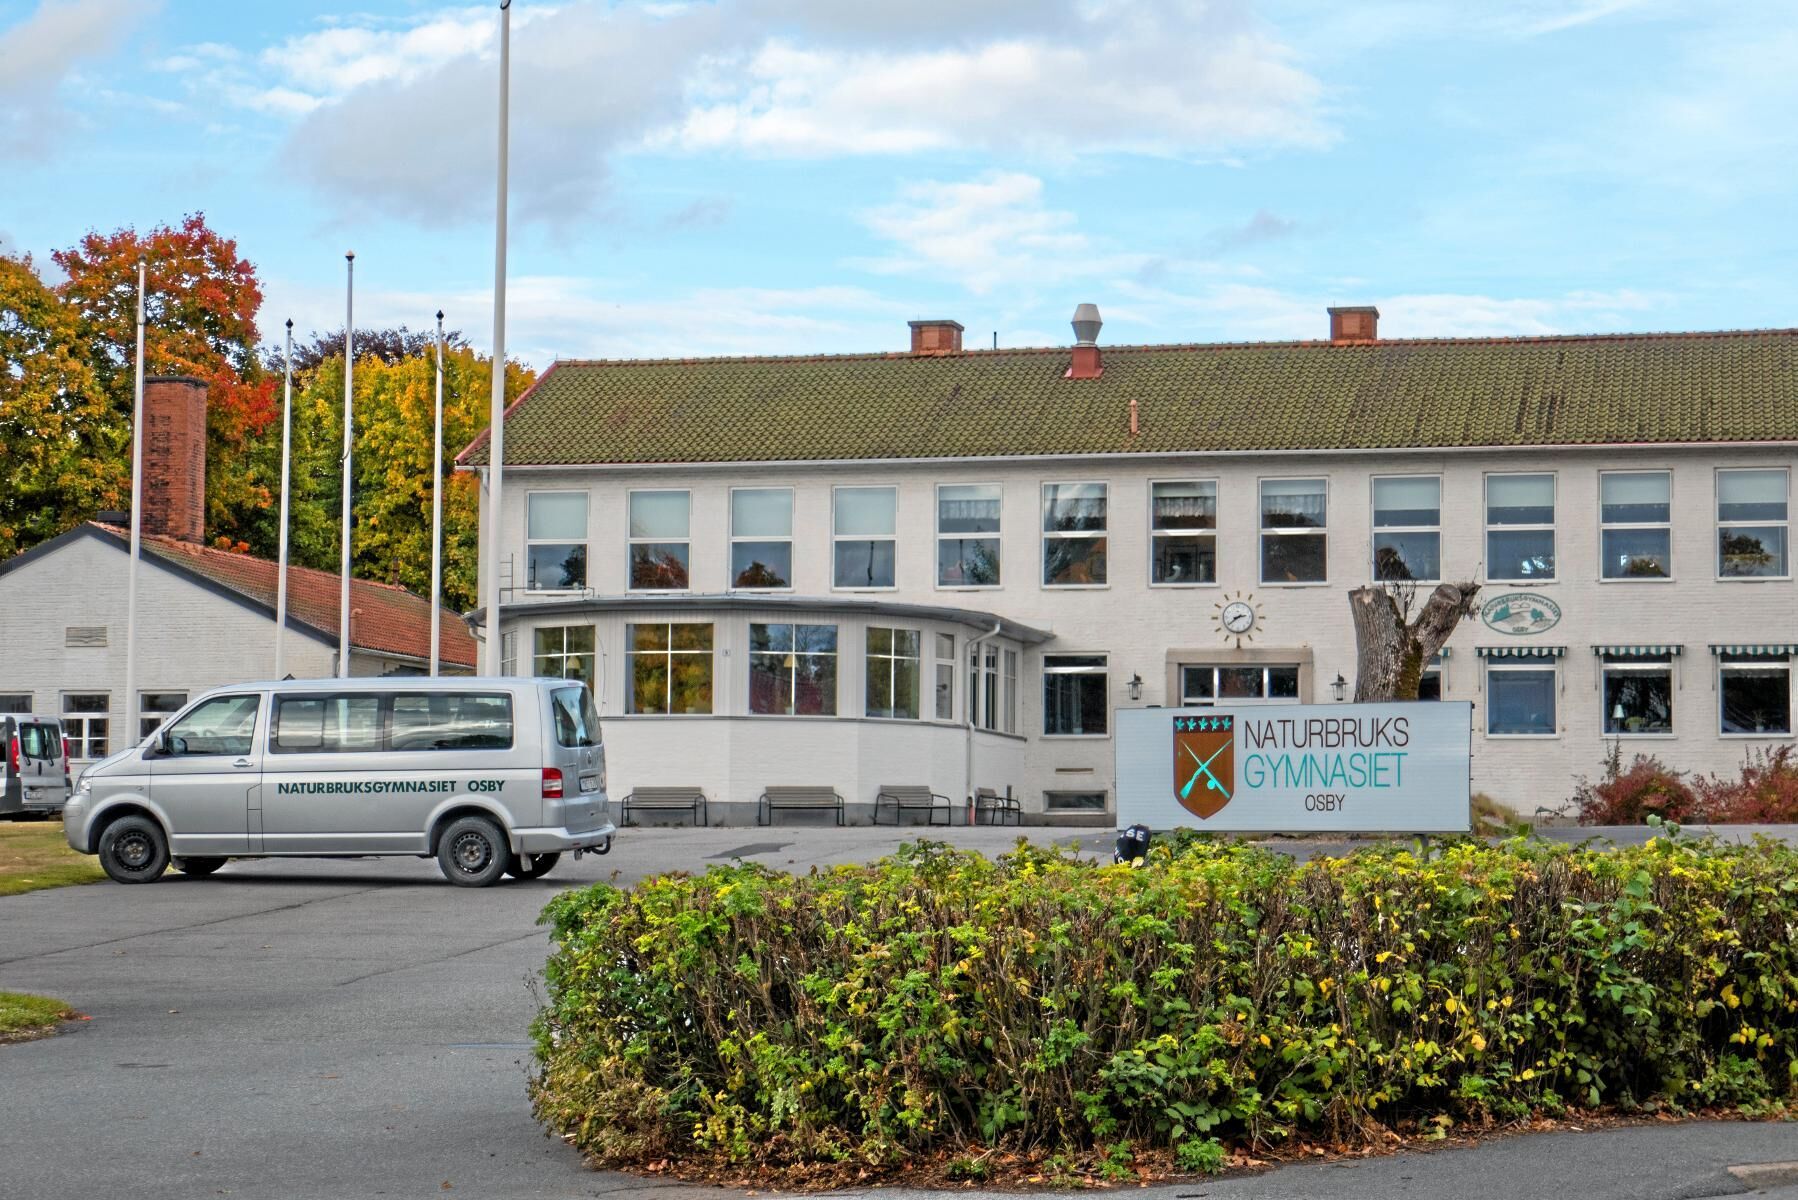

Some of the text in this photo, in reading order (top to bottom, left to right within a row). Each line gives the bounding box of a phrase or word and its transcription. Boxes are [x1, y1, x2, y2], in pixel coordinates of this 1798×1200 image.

[1244, 717, 1410, 749] NATURBRUKS
[1244, 752, 1409, 788] GYMNASIET
[277, 780, 505, 794] NATURBRUKSGYMNASIET OSBY
[1304, 794, 1346, 811] OSBY
